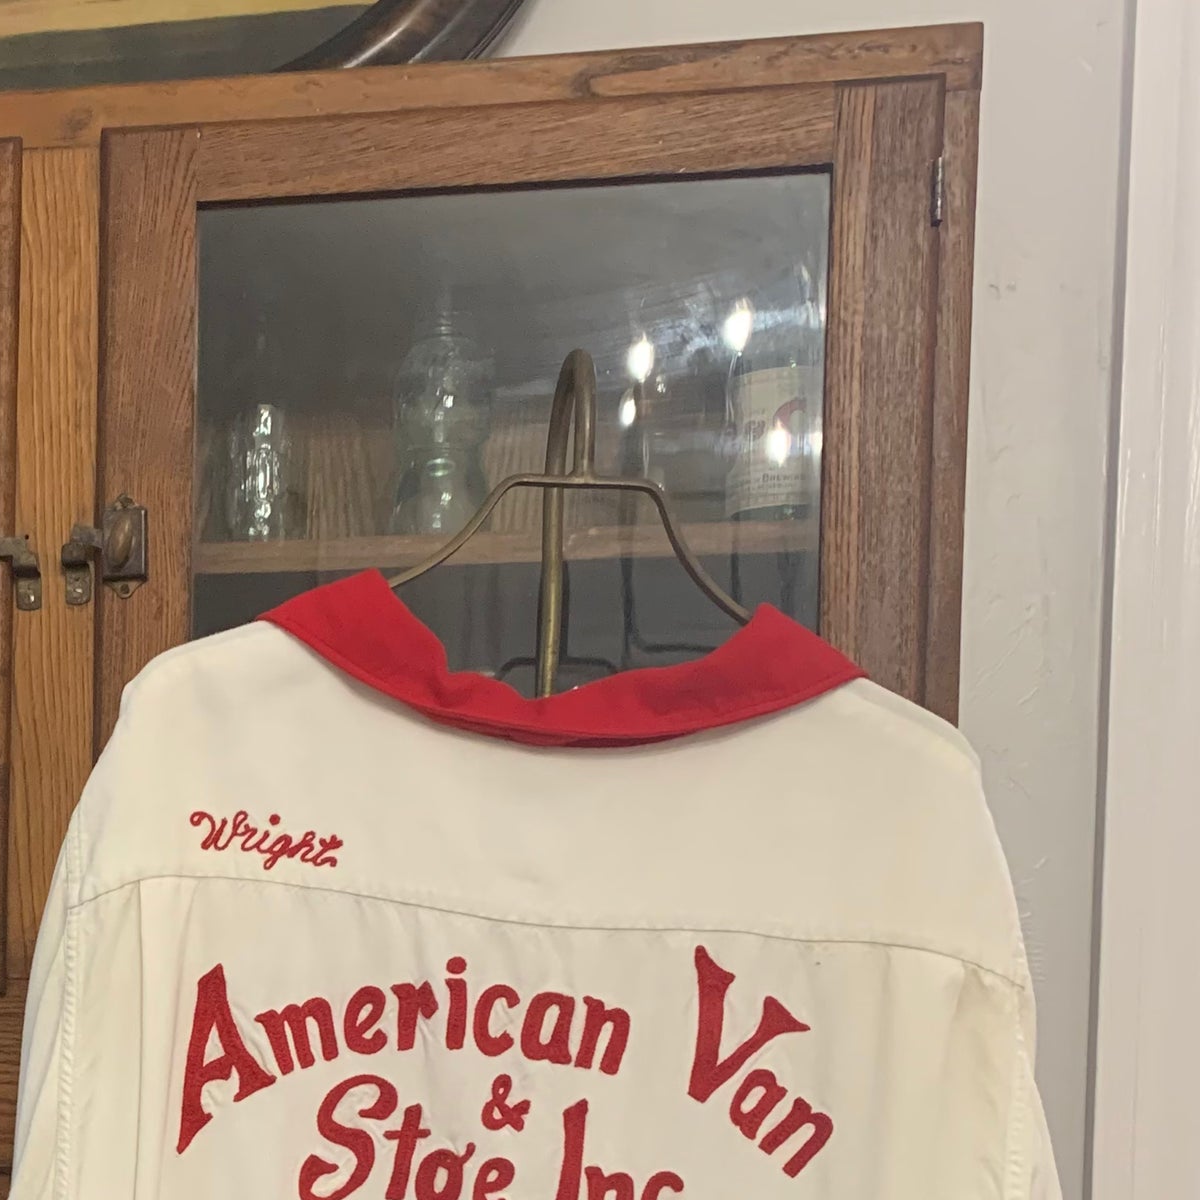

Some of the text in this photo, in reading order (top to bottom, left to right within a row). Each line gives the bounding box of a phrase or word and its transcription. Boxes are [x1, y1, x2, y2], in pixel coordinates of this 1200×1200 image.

[189, 811, 343, 869] Wright
[176, 945, 834, 1178] American Van
[481, 1074, 531, 1132] &
